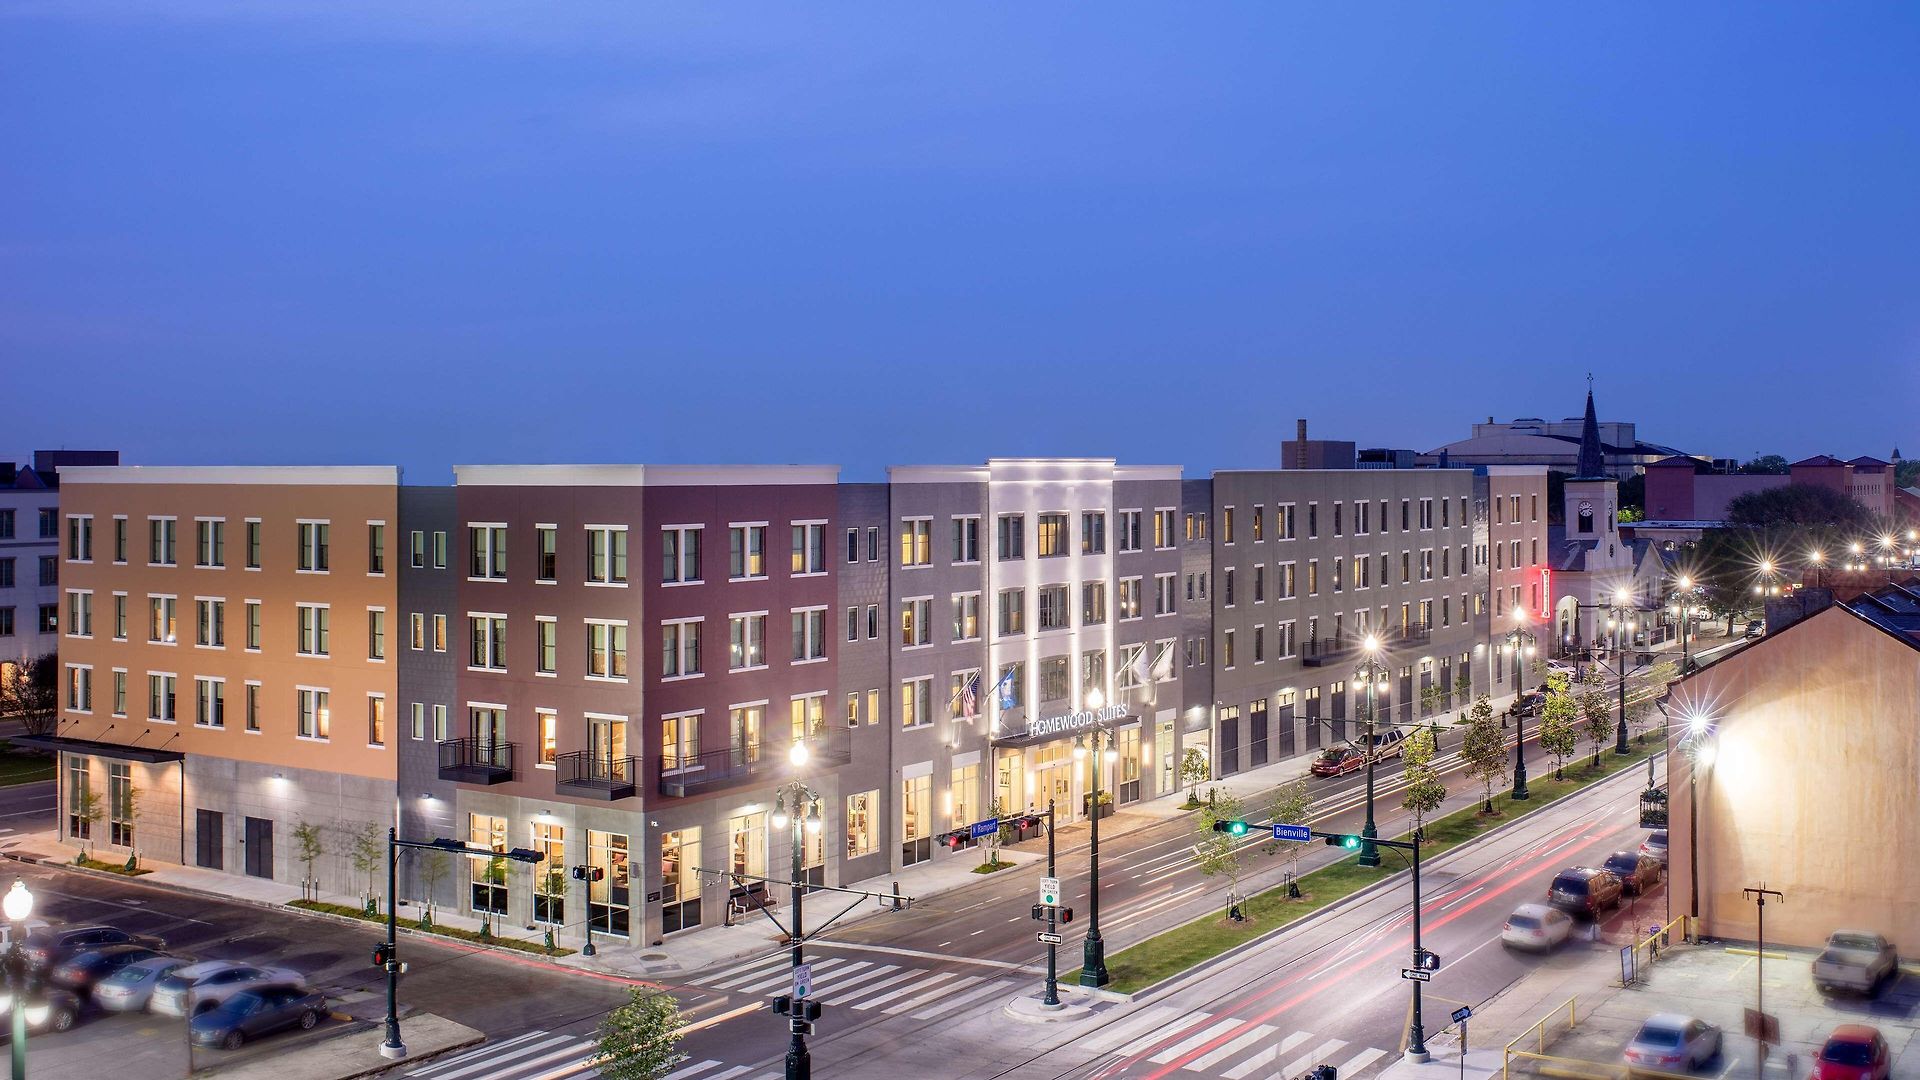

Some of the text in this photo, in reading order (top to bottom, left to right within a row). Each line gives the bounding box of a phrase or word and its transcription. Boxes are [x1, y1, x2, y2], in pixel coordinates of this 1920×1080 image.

[1029, 704, 1127, 736] HOMEWOOD SUITES
[978, 820, 996, 833] Rampart
[1276, 826, 1308, 838] Bienville
